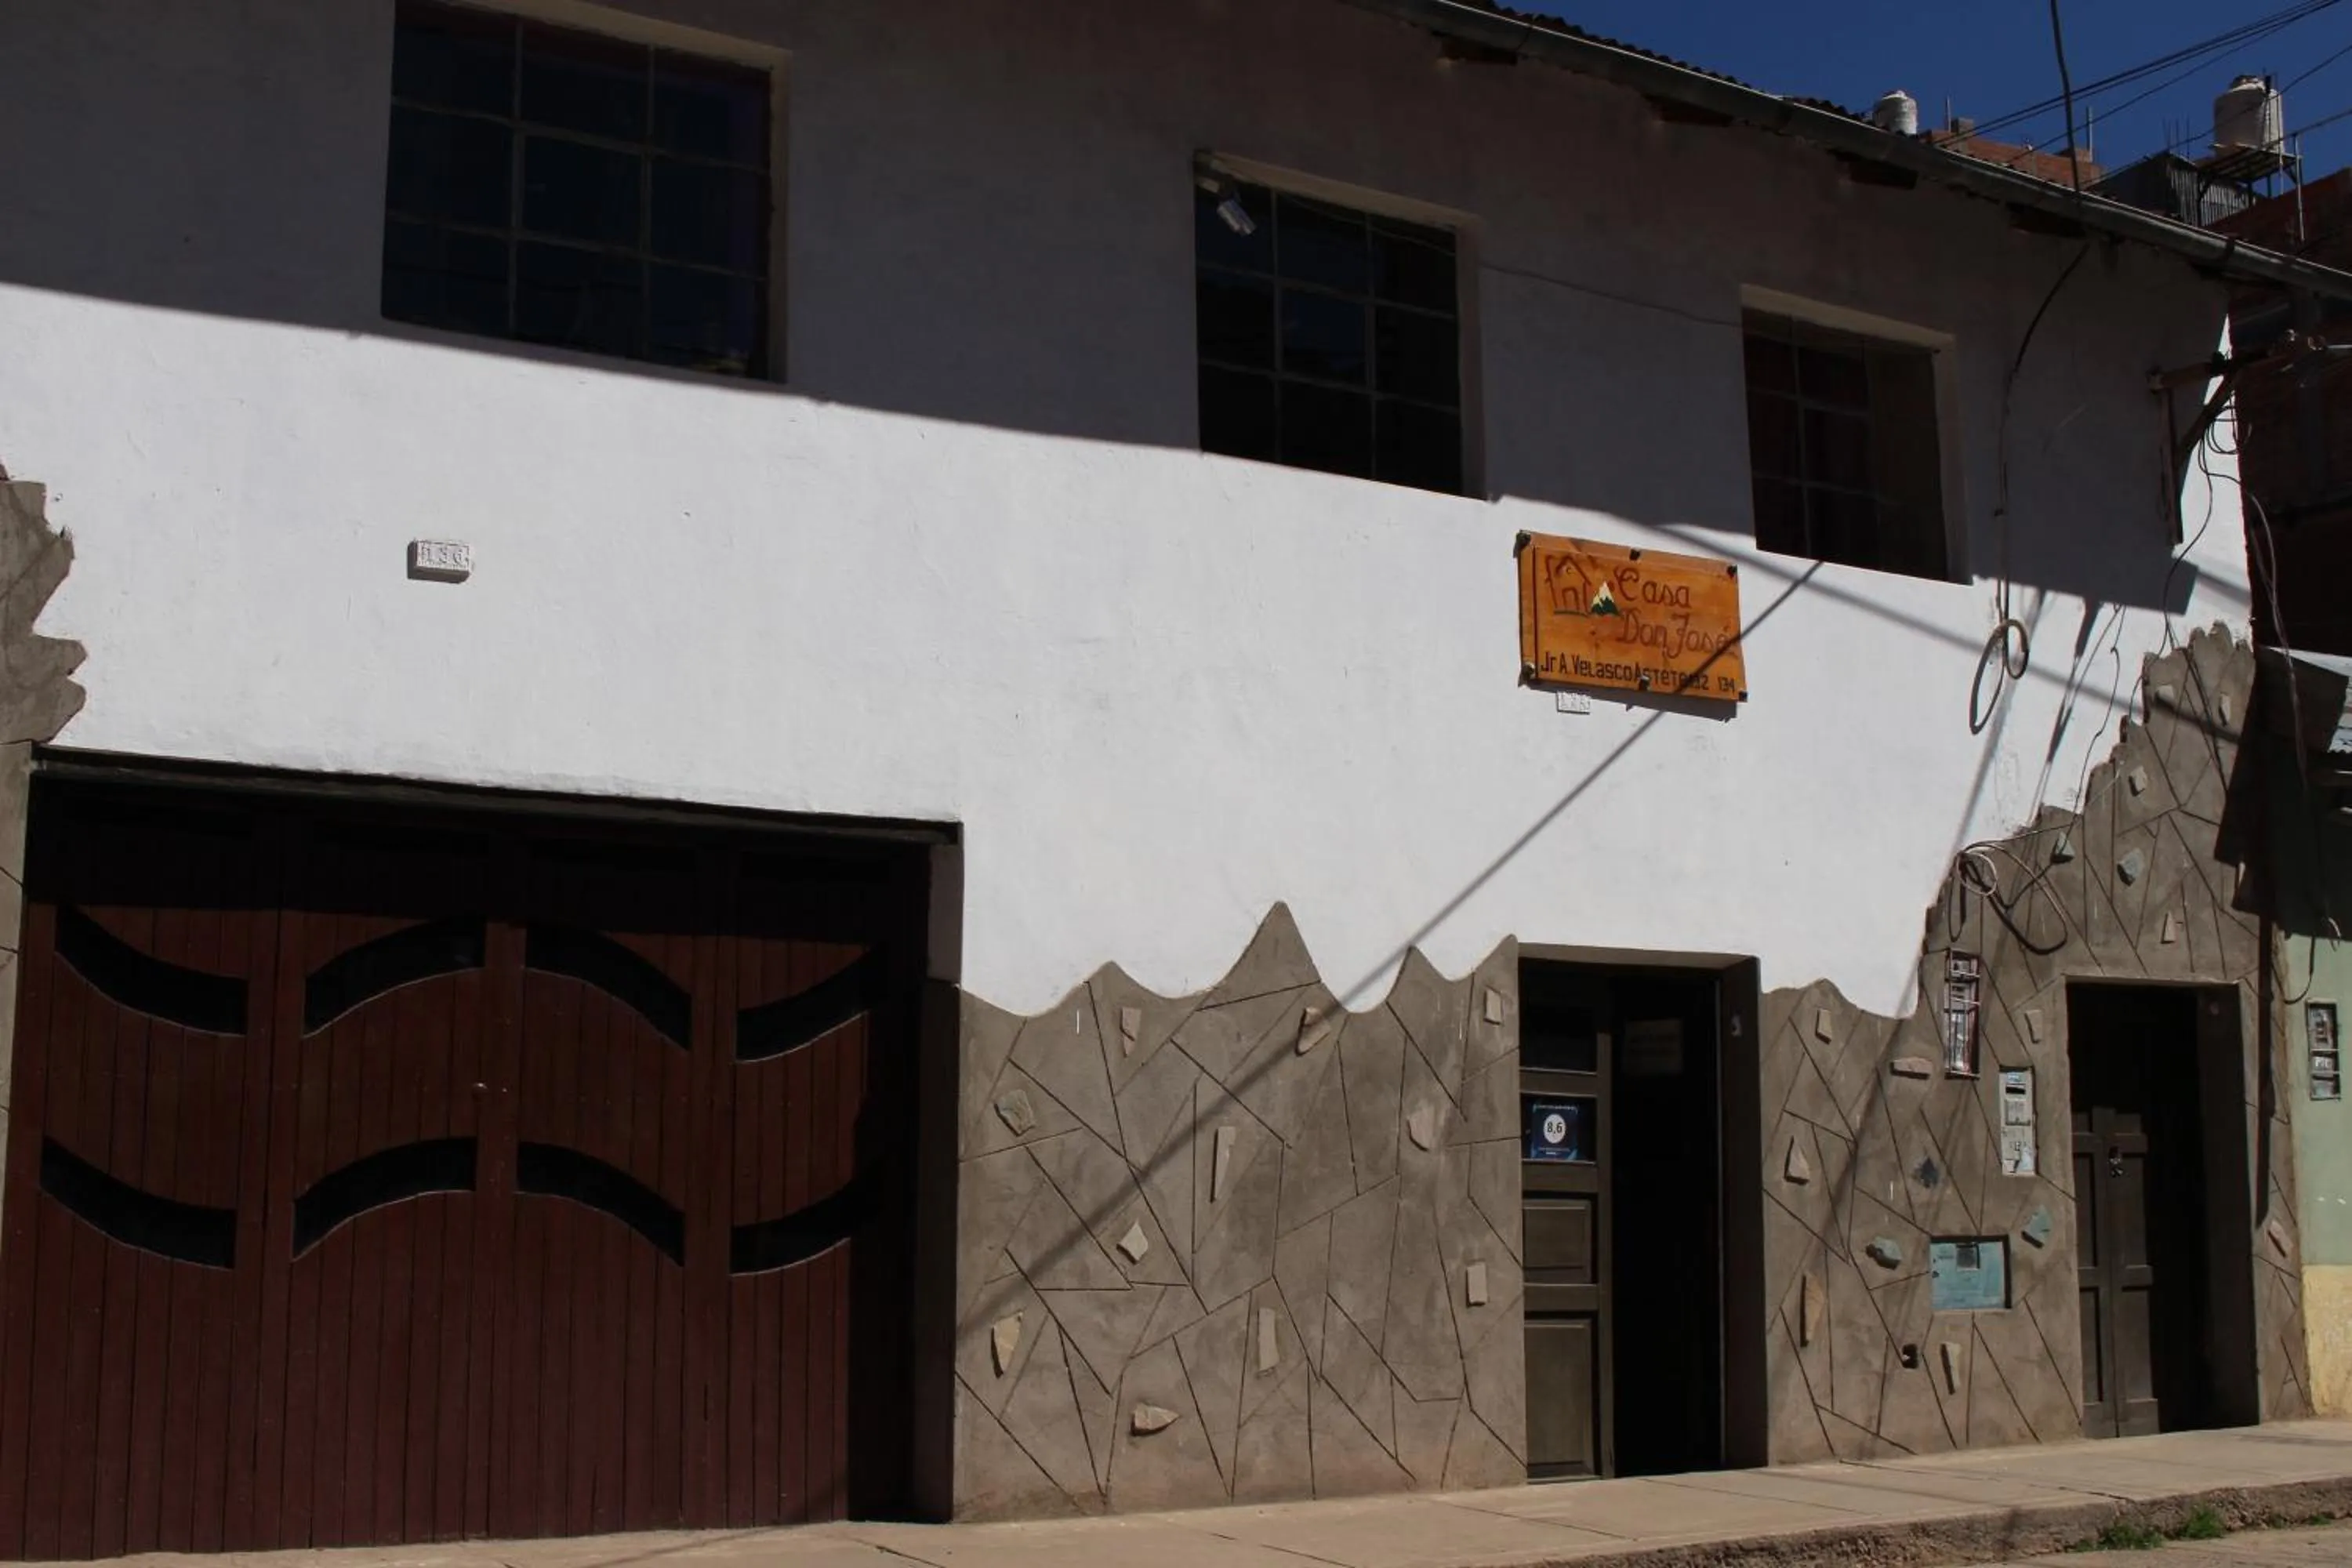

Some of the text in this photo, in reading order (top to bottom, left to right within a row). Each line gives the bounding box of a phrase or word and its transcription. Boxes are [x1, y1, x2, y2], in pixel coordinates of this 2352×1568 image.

[1613, 566, 1692, 608] Casa
[1616, 608, 1668, 648] Don
[1547, 1121, 1563, 1134] 8,6
